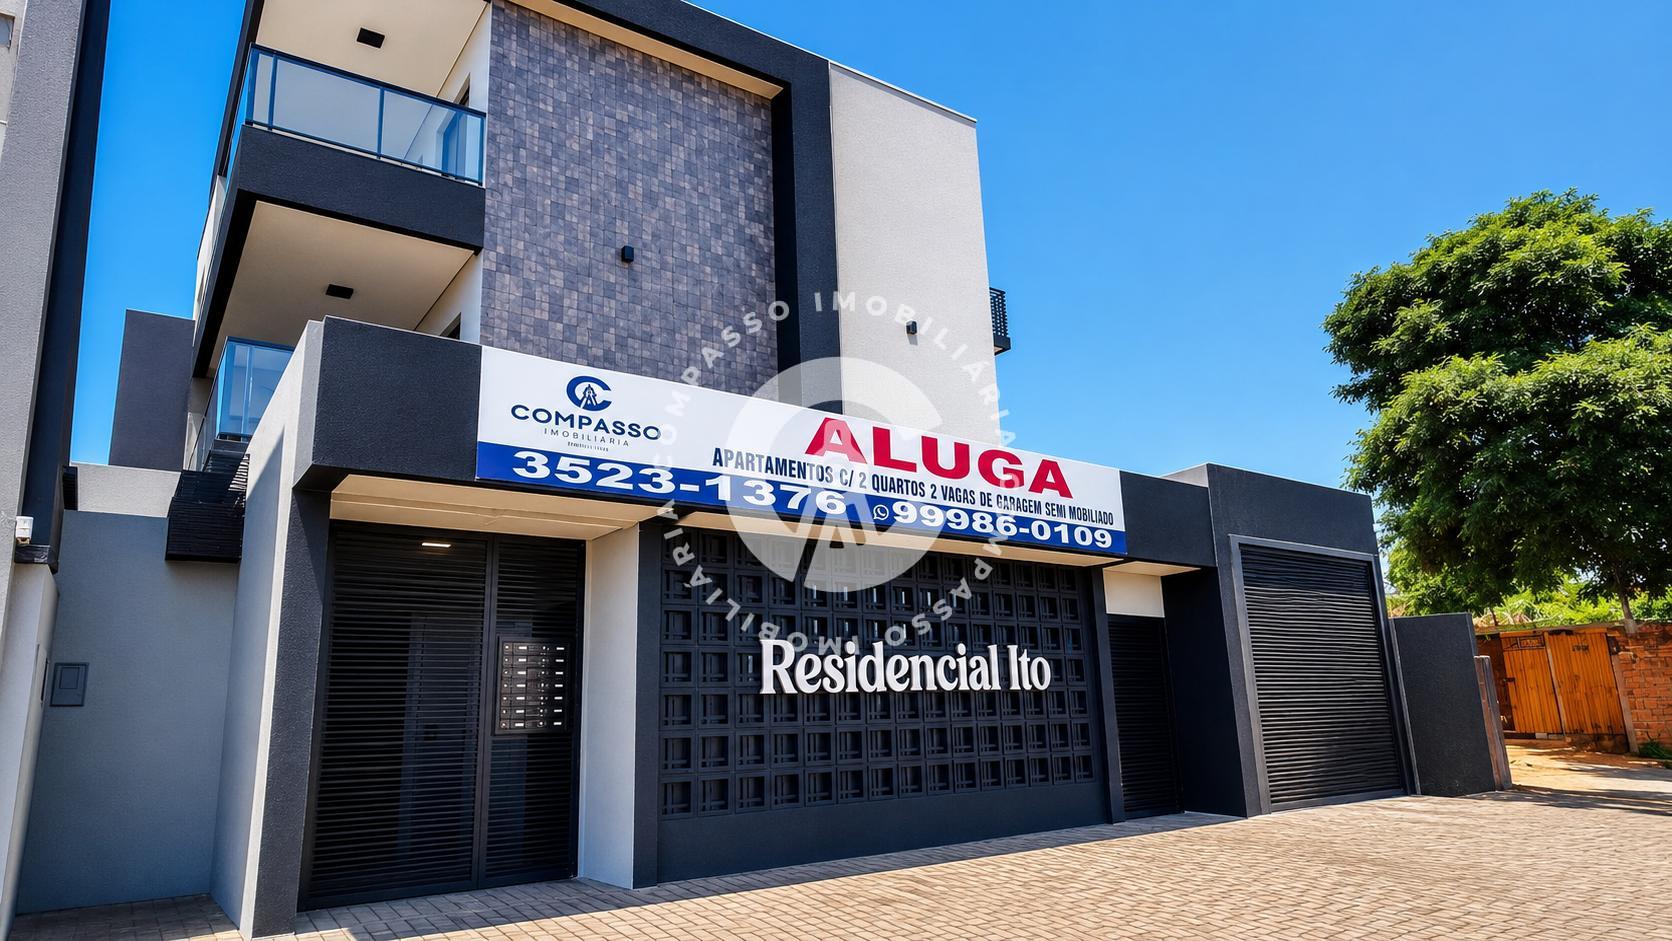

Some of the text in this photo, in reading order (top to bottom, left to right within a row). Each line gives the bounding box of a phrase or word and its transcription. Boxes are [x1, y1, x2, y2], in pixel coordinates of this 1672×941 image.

[511, 404, 662, 441] COMPASSO
[805, 417, 1074, 499] ALUGA
[512, 450, 1113, 549] 3523-1376 99986-0109
[712, 447, 1114, 526] APARTAMENTOS C/ 2 QUARTOS 2 VAGAS DE GARAGEM SEMI MOBILIADO
[759, 639, 1052, 695] Residencial Ito
